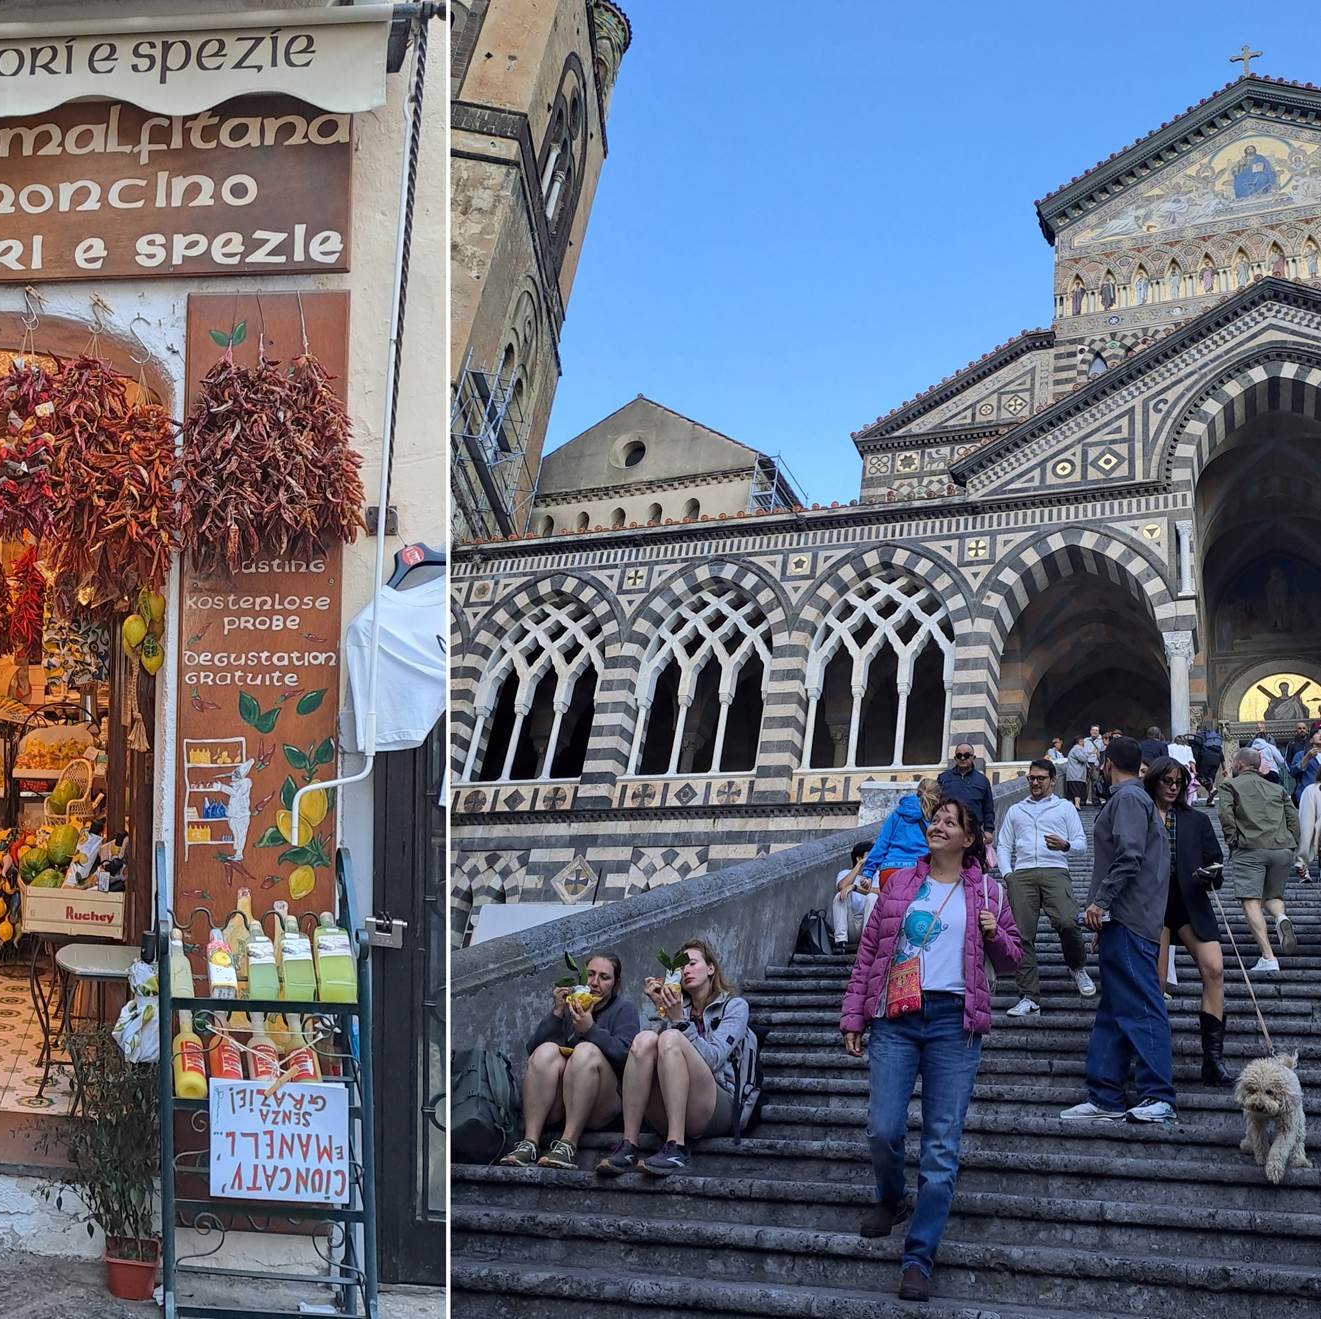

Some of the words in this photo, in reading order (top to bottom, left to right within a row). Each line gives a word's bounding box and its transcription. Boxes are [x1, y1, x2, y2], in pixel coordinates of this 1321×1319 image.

[87, 42, 119, 74] e
[74, 237, 108, 270] e
[231, 558, 326, 576] asting
[65, 905, 115, 924] Ruchey
[260, 1109, 313, 1128] SENZA
